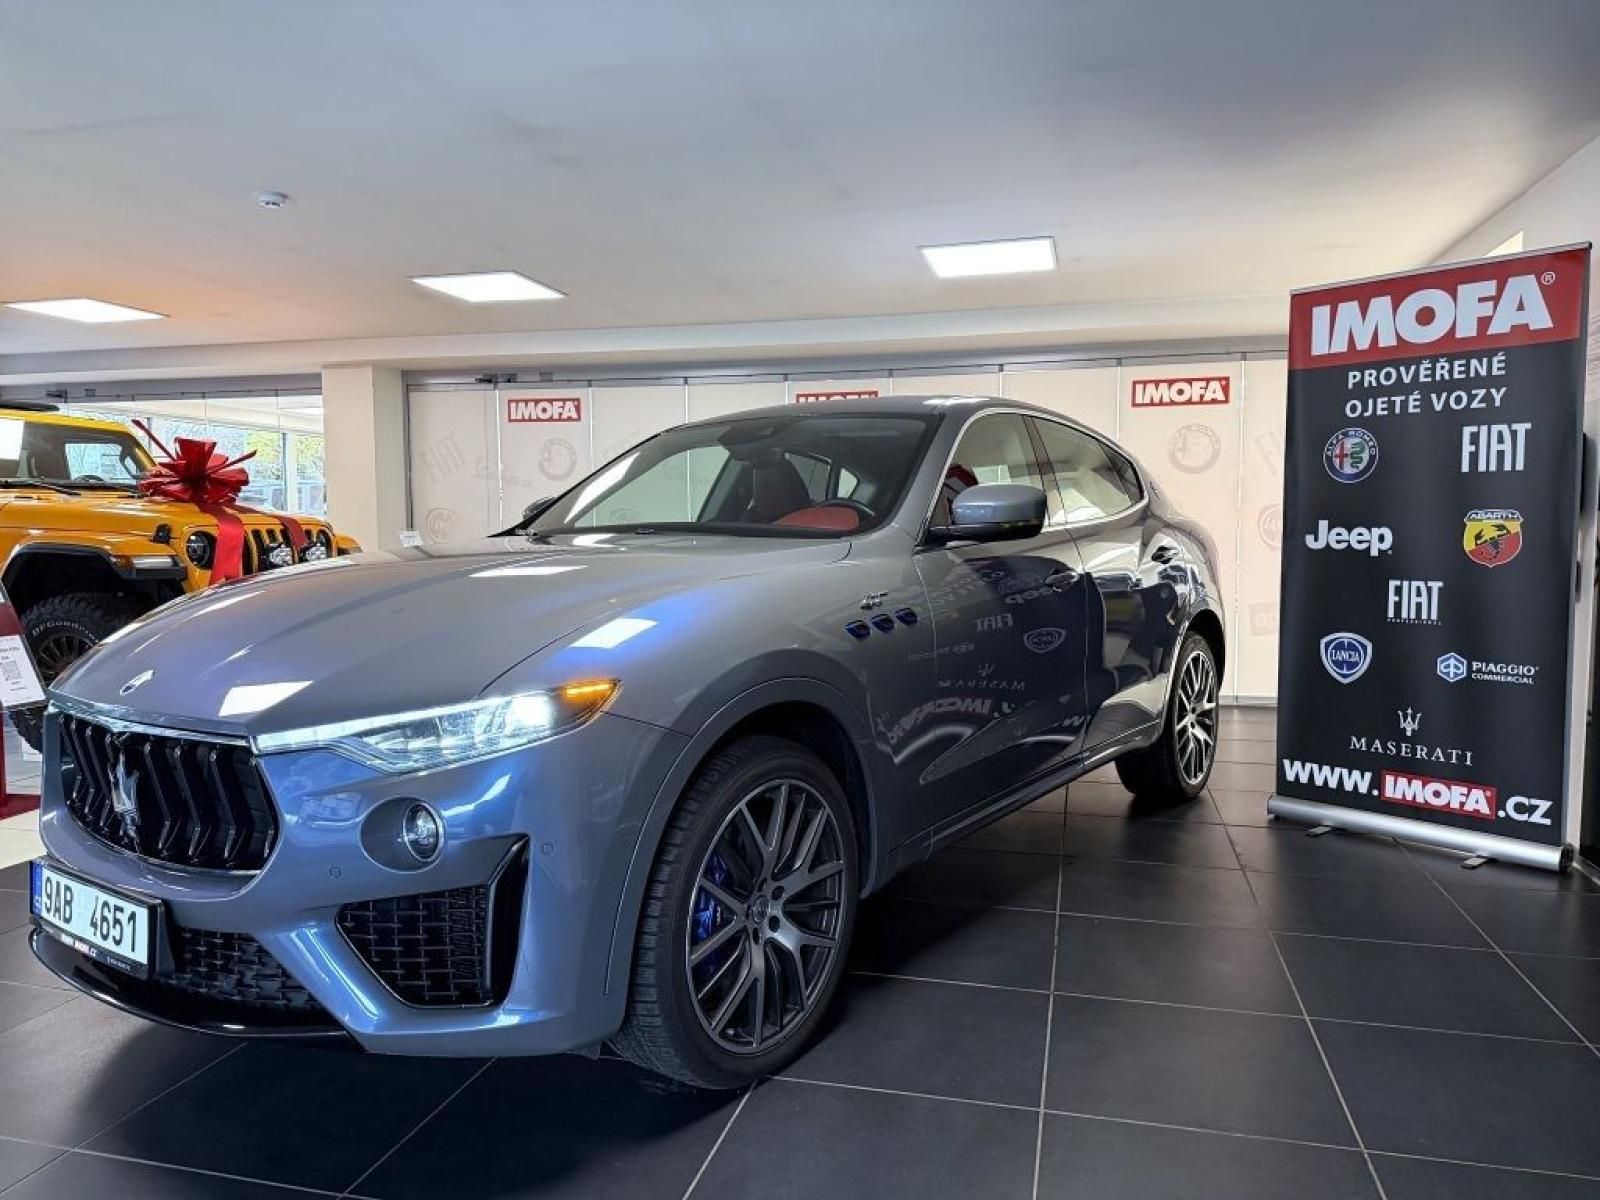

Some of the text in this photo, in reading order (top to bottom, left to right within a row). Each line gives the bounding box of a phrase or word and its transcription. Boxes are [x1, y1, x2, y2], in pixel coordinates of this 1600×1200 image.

[1311, 274, 1553, 356] IMOFA
[1347, 351, 1507, 389] PROVĚŘENÉ
[1135, 379, 1227, 405] IMOFA
[1344, 386, 1508, 418] OJETÉ VOZY
[509, 401, 579, 420] IMOFA
[1460, 422, 1531, 473] FIAT
[1304, 519, 1393, 557] Jeep
[1387, 579, 1444, 620] FIAT
[1471, 660, 1535, 676] PIAGGIO
[1471, 673, 1534, 685] COMMERCIAL
[1350, 735, 1474, 767] MASERATI
[44, 877, 73, 925] 9AB
[90, 895, 137, 953] 4651
